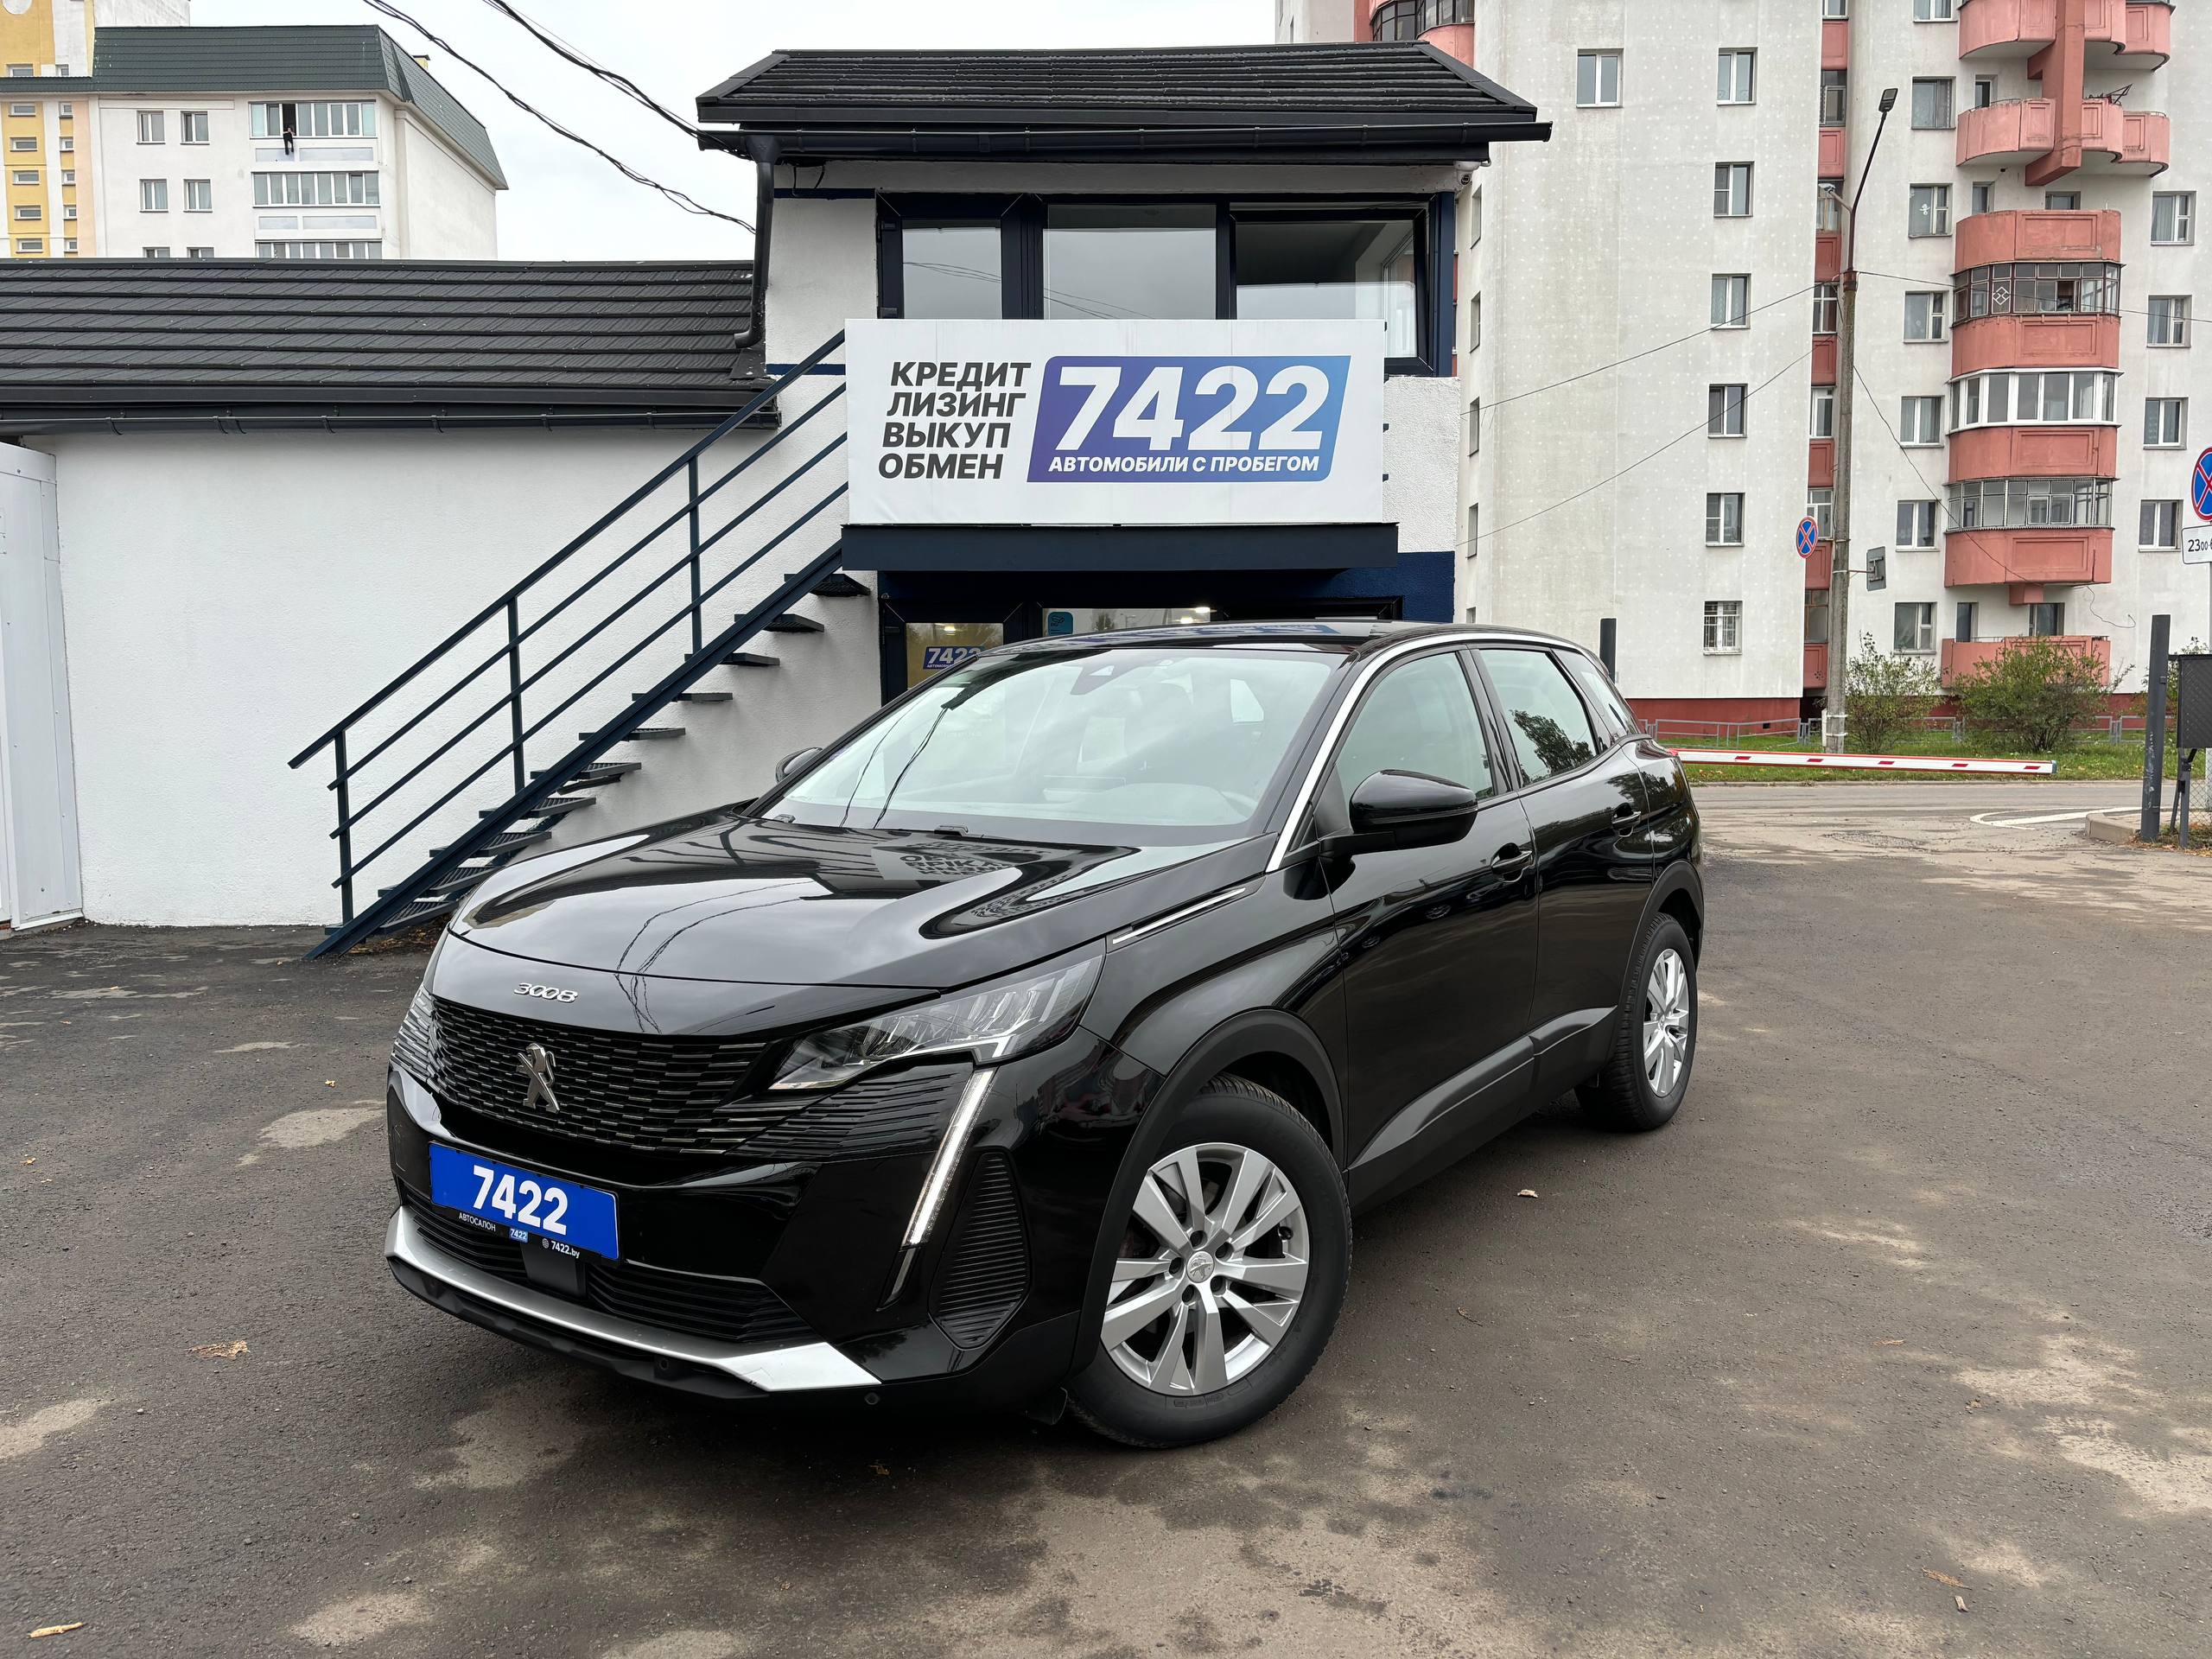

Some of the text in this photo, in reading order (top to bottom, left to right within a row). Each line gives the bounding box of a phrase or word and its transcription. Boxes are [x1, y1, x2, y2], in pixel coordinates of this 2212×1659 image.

[890, 361, 1032, 391] КРЕДИТ
[886, 391, 1027, 416] ЛИЗИНГ
[1054, 365, 1330, 450] 7422
[881, 422, 1011, 448] ВЫКУП
[878, 453, 1004, 480] ОБМЕН
[1048, 455, 1319, 473] АВТОМОБИЛИ С ПРОБЕГОМ
[513, 982, 579, 1003] 3008
[473, 1164, 569, 1236] 7422
[458, 1211, 497, 1232] АВТОСАЛОН
[509, 1228, 528, 1240] 7422
[550, 1240, 581, 1259] 7422.by
